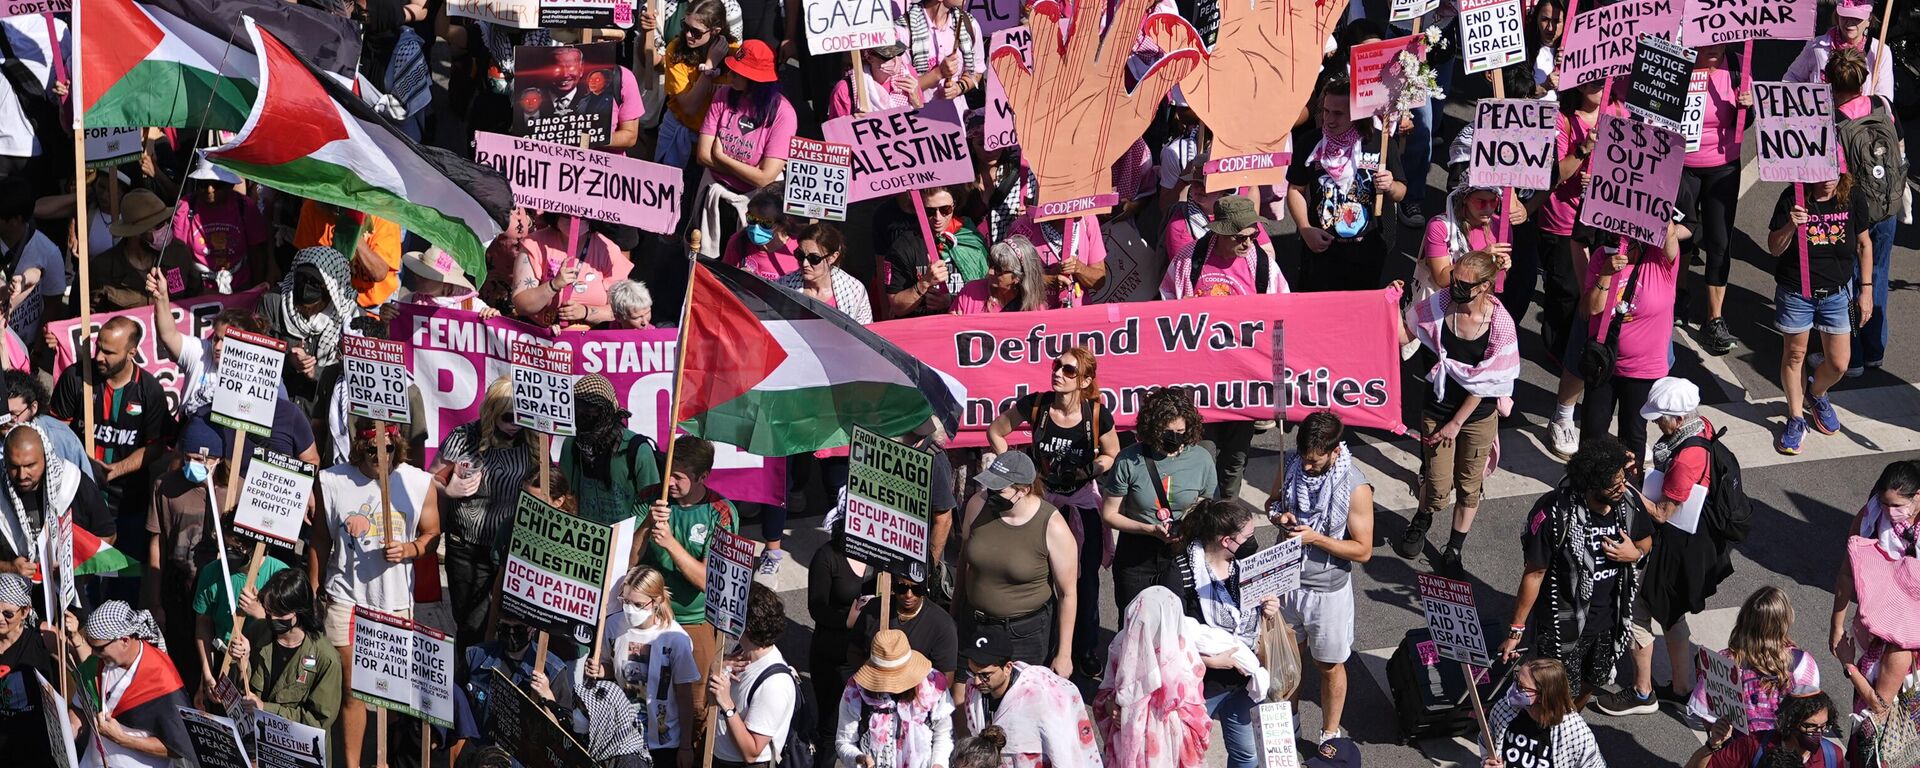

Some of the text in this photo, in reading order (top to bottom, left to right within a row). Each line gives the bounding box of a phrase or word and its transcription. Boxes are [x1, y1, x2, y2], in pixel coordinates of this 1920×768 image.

[807, 0, 889, 35] GAZA
[1466, 10, 1491, 26] END
[1496, 4, 1516, 18] U.S
[1574, 1, 1671, 34] FEMINISM
[1692, 6, 1796, 33] TO WAR
[1468, 18, 1518, 41] AID TO
[1599, 20, 1639, 41] NOT
[1712, 29, 1773, 43] CODEPINK
[821, 32, 888, 51] CODEPINK
[1469, 33, 1520, 55] ISRAEL!
[1639, 50, 1687, 75] JUSTICE.
[1641, 62, 1679, 86] PEACE.
[1651, 79, 1666, 89] AND
[1633, 81, 1680, 106] EQUALITY!
[1754, 84, 1829, 119] PEACE
[1477, 103, 1554, 130] PEACE
[1625, 104, 1635, 112] END
[527, 114, 599, 127] DEMOCRATS
[535, 121, 591, 133] FUND THE
[851, 110, 928, 145] FREE
[84, 127, 107, 139] FOR
[1760, 127, 1827, 159] NOW
[514, 139, 611, 168] DEMOCRATS ARE
[790, 149, 849, 165] PALESTINE!
[791, 138, 850, 155] STAND WITH
[1475, 141, 1548, 168] NOW
[1218, 153, 1274, 172] CODEPINK
[1607, 143, 1662, 174] OUT
[791, 162, 845, 179] END U.S
[1478, 171, 1545, 188] CODEPINK
[1612, 167, 1643, 186] OF
[1763, 166, 1833, 182] CODEPINK
[790, 175, 844, 193] AID TO
[870, 171, 941, 192] CODEPINK
[789, 187, 843, 206] ISRAEL!
[1044, 196, 1096, 215] CODEPINK
[1591, 175, 1672, 222] POLITICS
[1592, 211, 1654, 243] CODEPINK
[227, 328, 241, 337] STAND
[955, 313, 1264, 368] Defund War
[343, 336, 402, 353] STAND WITH
[345, 345, 404, 364] PALESTINE!
[513, 342, 571, 362] STAND WITH
[224, 345, 279, 368] IMMIGRANT
[513, 353, 571, 373] PALESTINE!
[581, 341, 678, 373] STAND
[221, 367, 276, 388] LEGALIZATION
[222, 357, 277, 379] RIGHTS AND
[348, 360, 402, 378] END U.S
[219, 377, 274, 402] FOR ALL!
[350, 374, 403, 393] AID TO
[515, 370, 568, 390] END U.S
[351, 387, 405, 407] ISRAEL!
[516, 384, 570, 404] AID TO
[516, 398, 571, 420] ISRAEL!
[854, 429, 877, 447] FROM
[1051, 437, 1073, 448] FREE
[267, 451, 302, 467] STAND WITH
[852, 441, 928, 488] CHICAGO
[250, 477, 292, 496] LGBTQIA+
[262, 471, 296, 488] DEFEND
[246, 486, 302, 509] REPRODUCTIVE
[520, 495, 545, 514] FROM
[850, 475, 926, 519] PALESTINE
[916, 488, 927, 500] TO
[251, 498, 290, 517] RIGHTS!
[849, 500, 924, 540] OCCUPATION
[233, 526, 244, 535] END
[254, 533, 264, 541] AID
[516, 505, 606, 557] CHICAGO
[713, 526, 754, 554] STAND WITH
[848, 516, 860, 533] IS
[867, 524, 875, 538] A
[881, 528, 923, 557] CRIME!
[511, 537, 601, 585] PALESTINE
[590, 557, 601, 568] TO
[711, 539, 752, 567] PALESTINE!
[709, 555, 748, 584] END U.S
[508, 560, 597, 604] OCCUPATION
[707, 572, 746, 601] AID TO
[1418, 575, 1470, 594] STAND WITH
[507, 576, 520, 592] IS
[526, 586, 536, 600] A
[542, 592, 594, 619] CRIME!
[707, 589, 745, 619] ISRAEL!
[1420, 585, 1473, 605] PALESTINE!
[1426, 600, 1474, 621] END U.S
[356, 623, 408, 646] IMMIGRANT
[1430, 615, 1478, 635] AID TO
[356, 635, 407, 657] RIGHTS AND
[412, 635, 440, 652] STOP
[1433, 629, 1483, 650] ISRAEL!
[355, 645, 407, 666] LEGALIZATION
[355, 655, 407, 680] FOR ALL!
[412, 663, 447, 686] RIMES!
[1708, 654, 1729, 682] NOT
[429, 684, 449, 695] CONTROL
[1706, 678, 1740, 704] ANOTHER
[263, 716, 290, 733] LABOR
[190, 725, 235, 746] JUSTICE.
[267, 732, 310, 753] PALESTINE
[1506, 730, 1538, 751] NOT
[1283, 745, 1292, 753] BE
[1268, 755, 1294, 767] FREE
